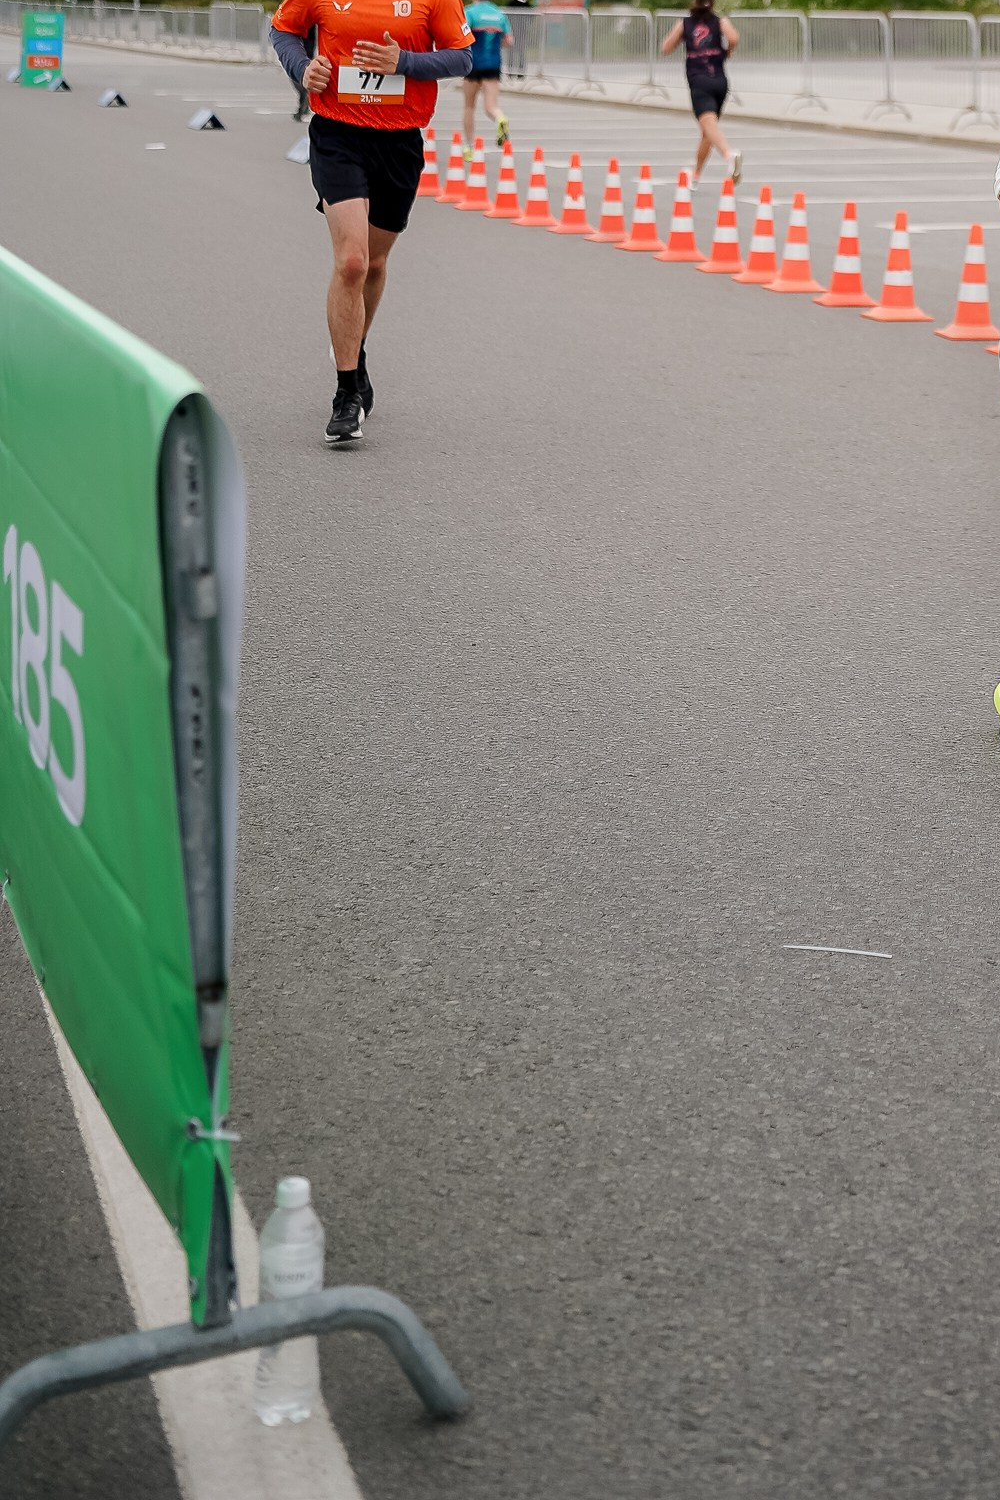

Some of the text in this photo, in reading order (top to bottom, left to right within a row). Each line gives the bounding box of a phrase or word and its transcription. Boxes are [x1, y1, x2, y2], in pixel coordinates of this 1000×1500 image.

[392, 0, 411, 17] 10
[358, 72, 385, 90] 77
[3, 523, 86, 827] 185
